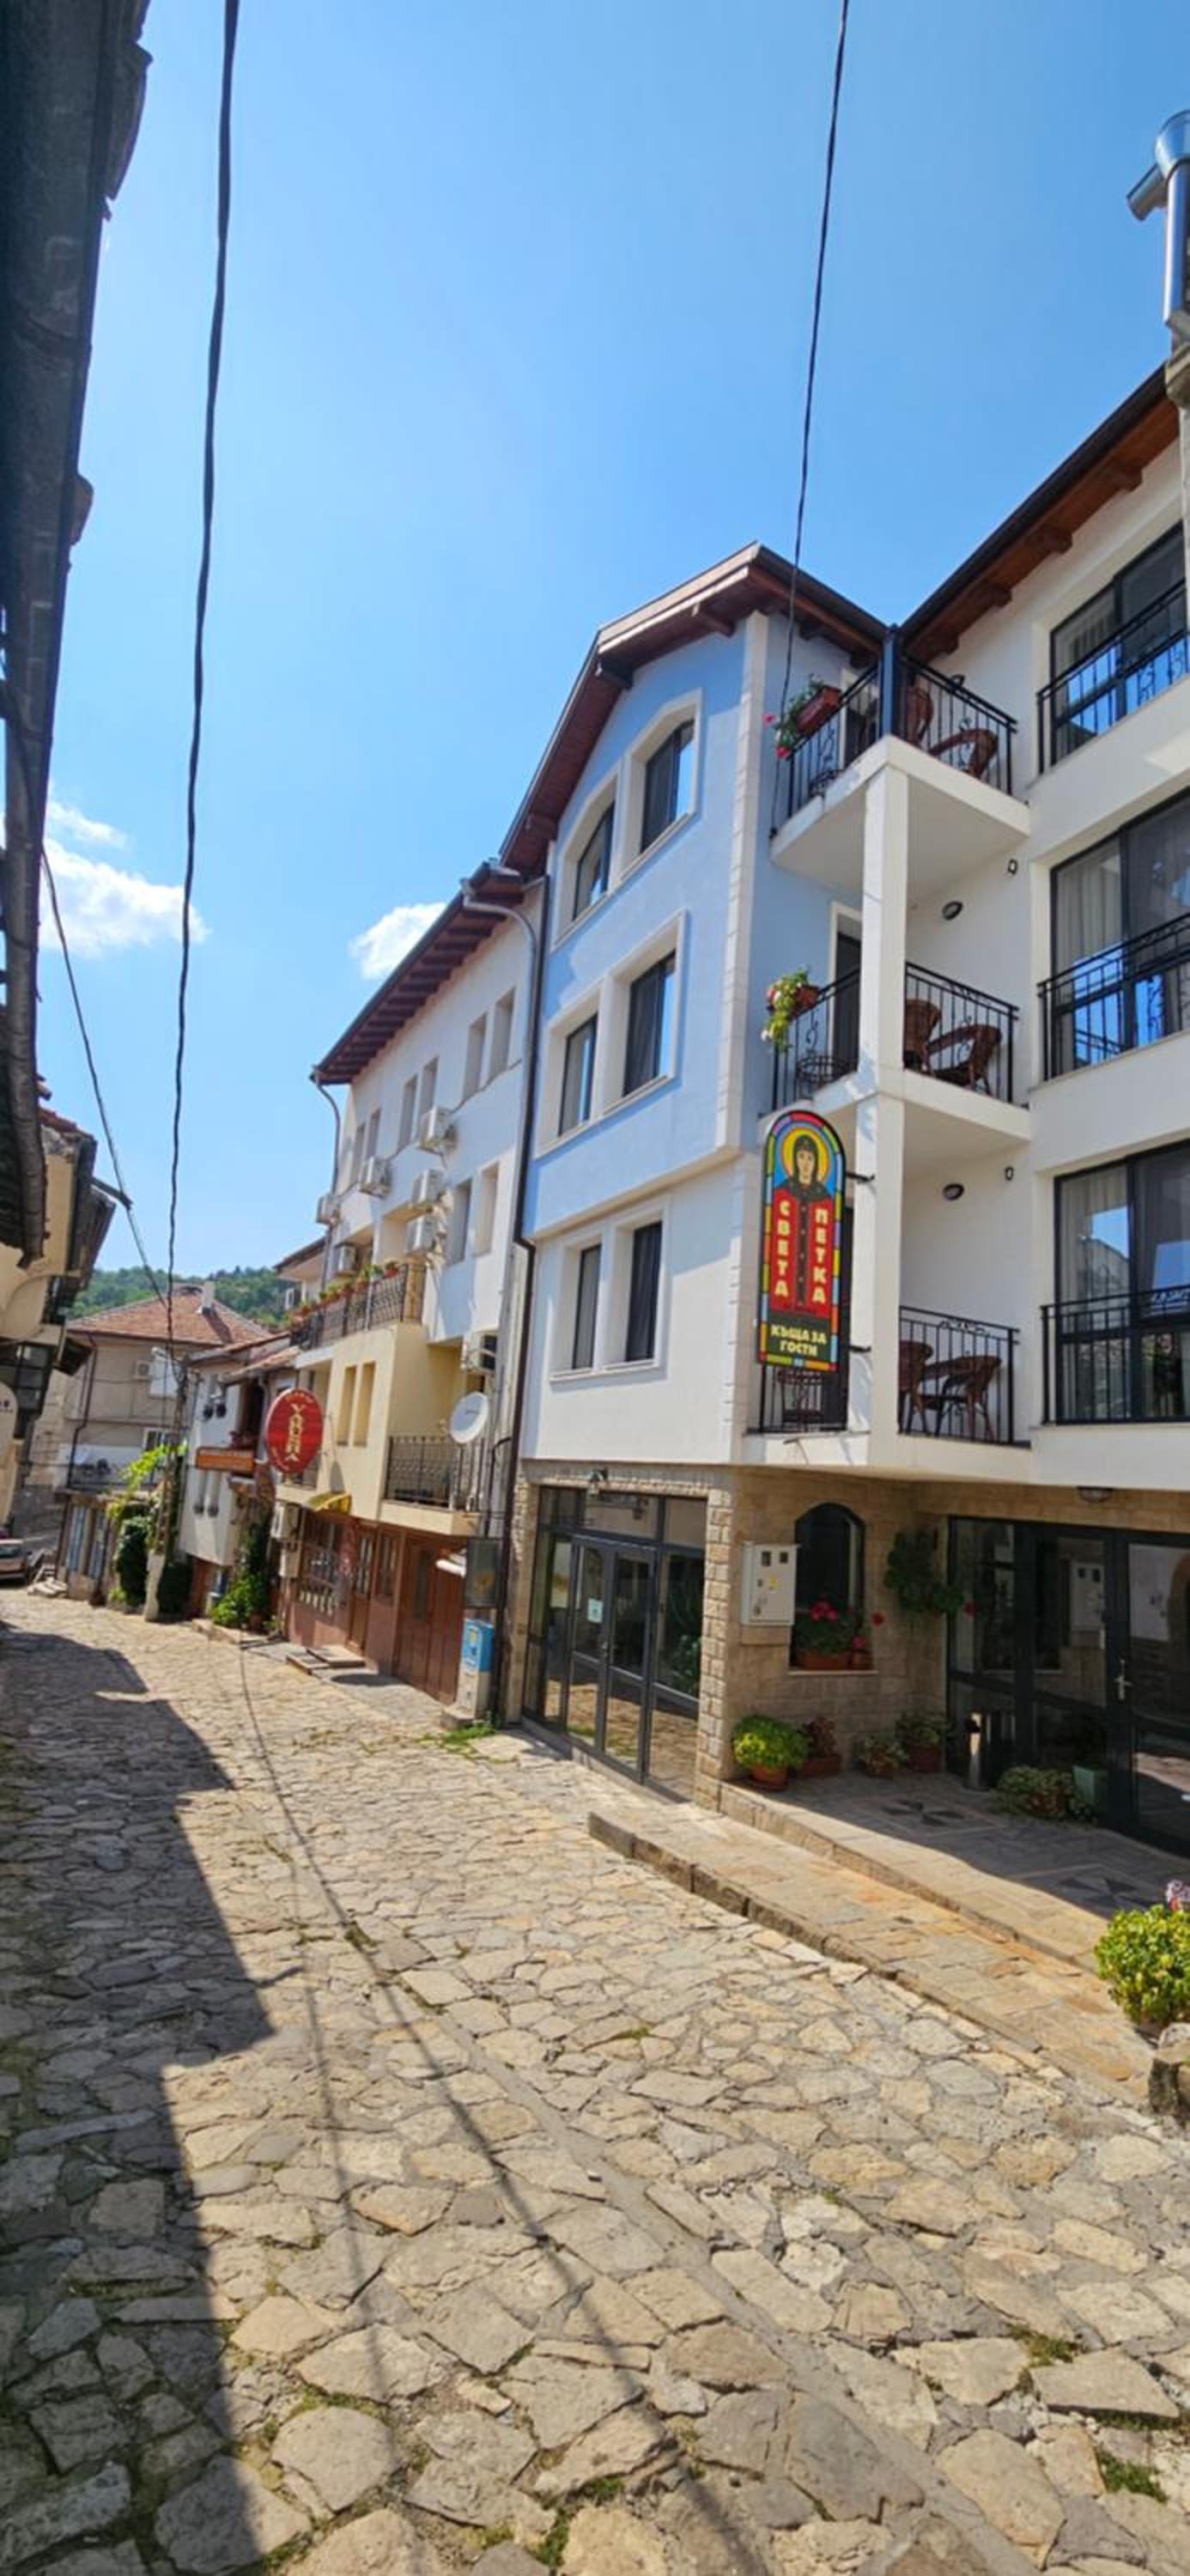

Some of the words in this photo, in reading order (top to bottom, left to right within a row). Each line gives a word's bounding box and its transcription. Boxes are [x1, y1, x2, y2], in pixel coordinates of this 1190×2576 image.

[775, 1200, 790, 1297] СВЕТА
[811, 1208, 829, 1304] ПЕТКА
[771, 1324, 810, 1341] КЪЩА
[811, 1331, 827, 1345] ЗА
[780, 1340, 818, 1357] ГОСТИ
